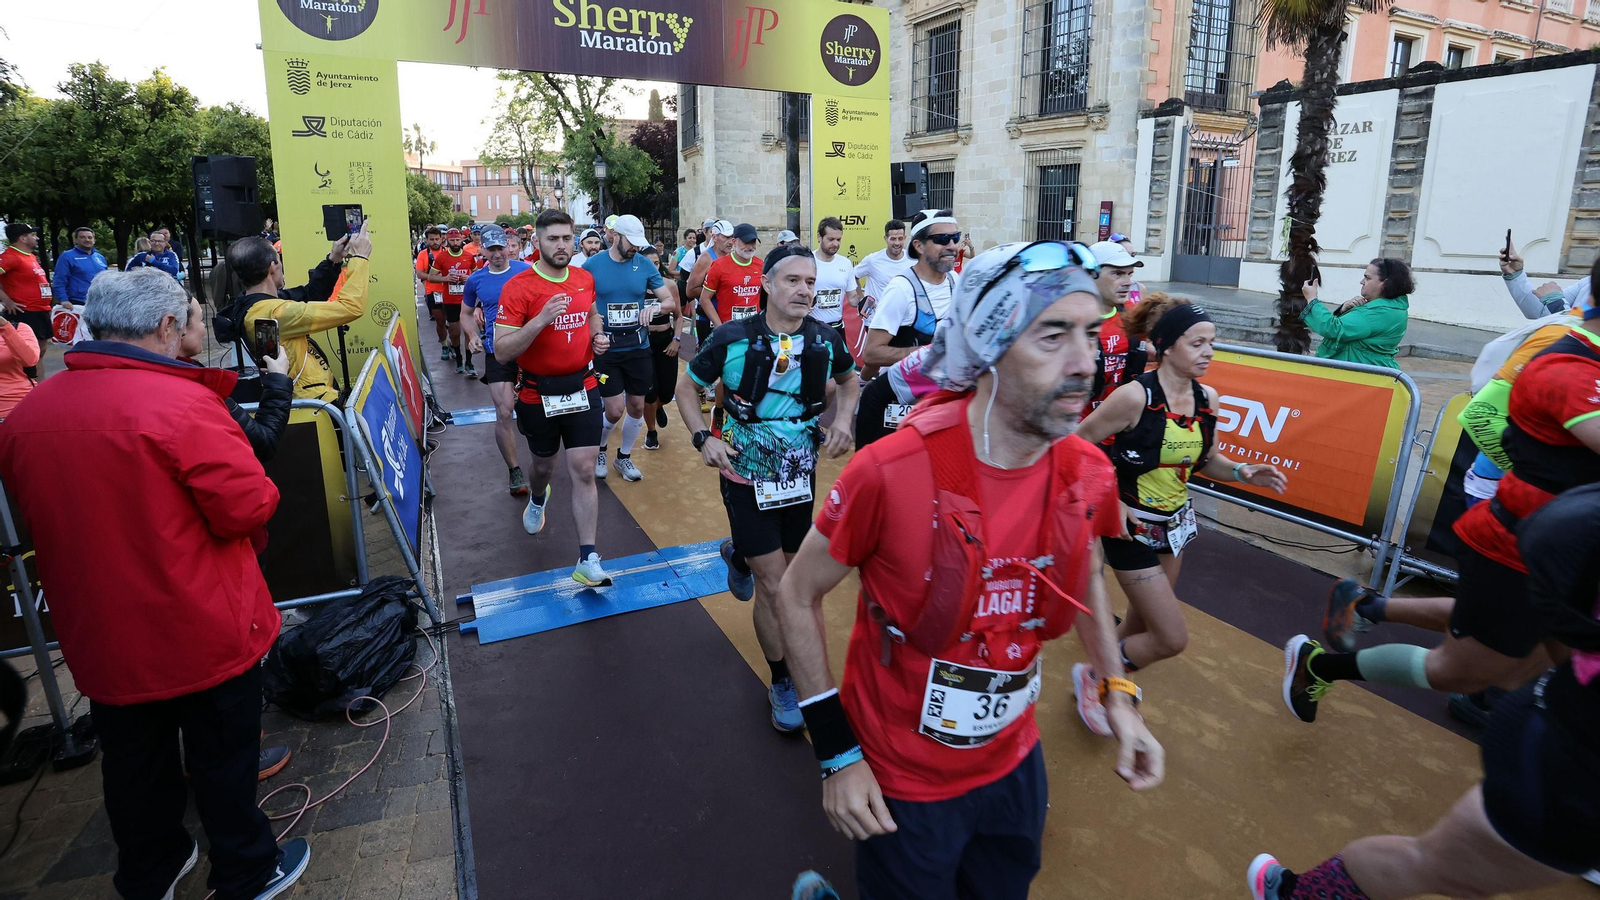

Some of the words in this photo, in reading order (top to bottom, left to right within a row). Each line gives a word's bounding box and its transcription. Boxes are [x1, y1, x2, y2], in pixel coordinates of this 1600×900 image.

[300, 0, 358, 13] Maratón
[554, 0, 694, 53] Sherry
[579, 30, 673, 56] Maratón
[825, 41, 876, 65] Sherry
[834, 55, 868, 66] Maratón
[316, 71, 379, 82] Ayuntamiento
[330, 80, 352, 88] Jerez
[842, 109, 879, 117] Ayuntamiento
[330, 117, 382, 128] Diputación
[1328, 121, 1373, 136] AZAR
[331, 130, 344, 138] de
[347, 130, 374, 139] Cádiz
[847, 142, 879, 151] Diputación
[857, 152, 873, 160] Cádiz
[1329, 151, 1358, 163] REZ
[839, 215, 866, 226] HSN
[553, 311, 589, 326] herry
[617, 310, 631, 319] 110
[1217, 395, 1291, 443] SN
[1218, 441, 1301, 471] UTRITION!
[977, 590, 1023, 618] LAGA
[973, 694, 1011, 721] 36
